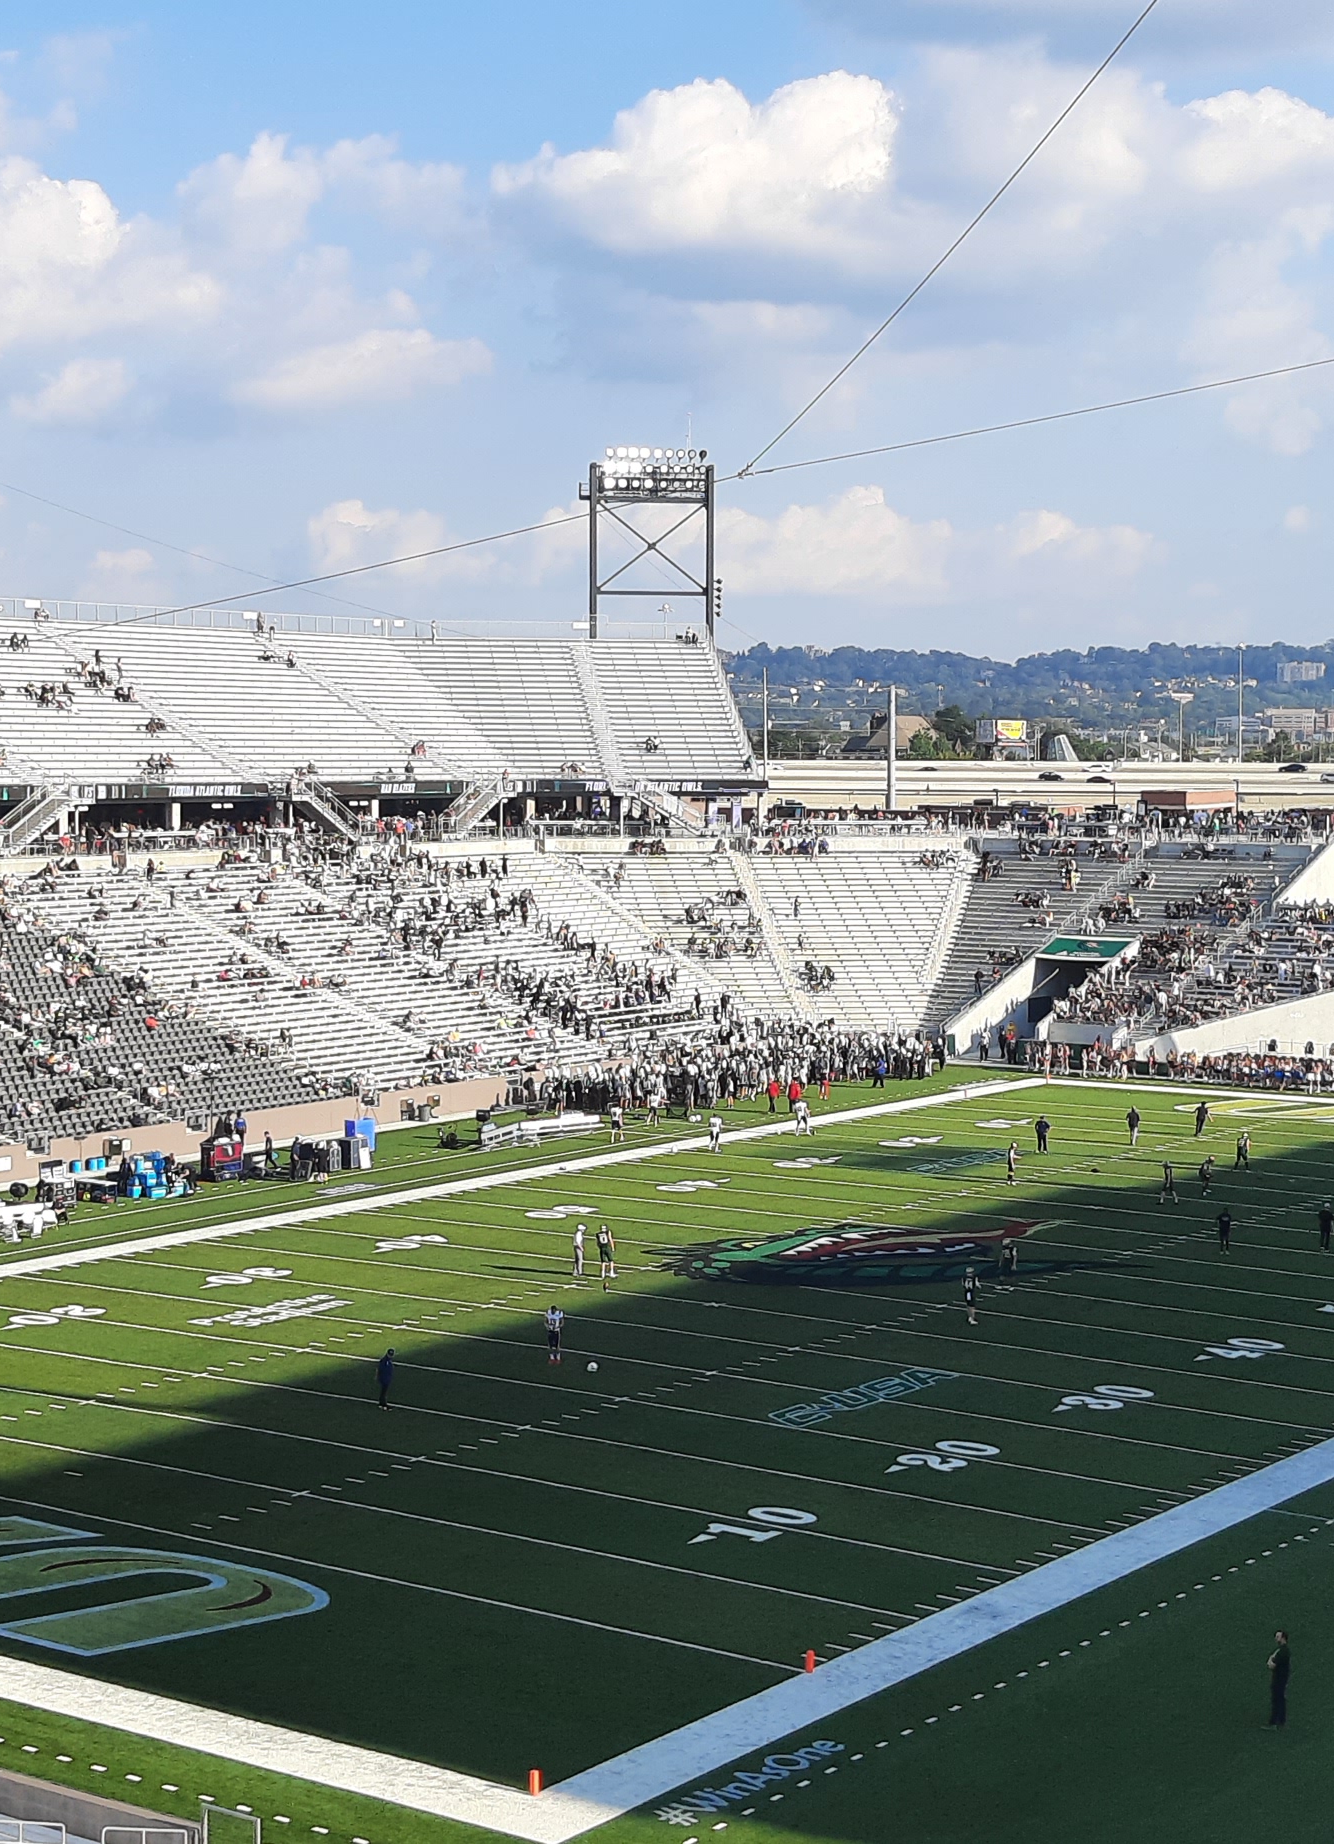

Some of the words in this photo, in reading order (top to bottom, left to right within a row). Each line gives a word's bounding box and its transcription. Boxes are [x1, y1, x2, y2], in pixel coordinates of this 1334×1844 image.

[9, 1304, 107, 1326] 20
[187, 1293, 336, 1327] Protective
[230, 1299, 355, 1328] Stadium
[1203, 1337, 1285, 1359] 40
[1061, 1385, 1155, 1410] 30
[896, 1439, 1001, 1472] 20
[706, 1507, 817, 1542] 10
[653, 1738, 846, 1827] #WinAsOne
